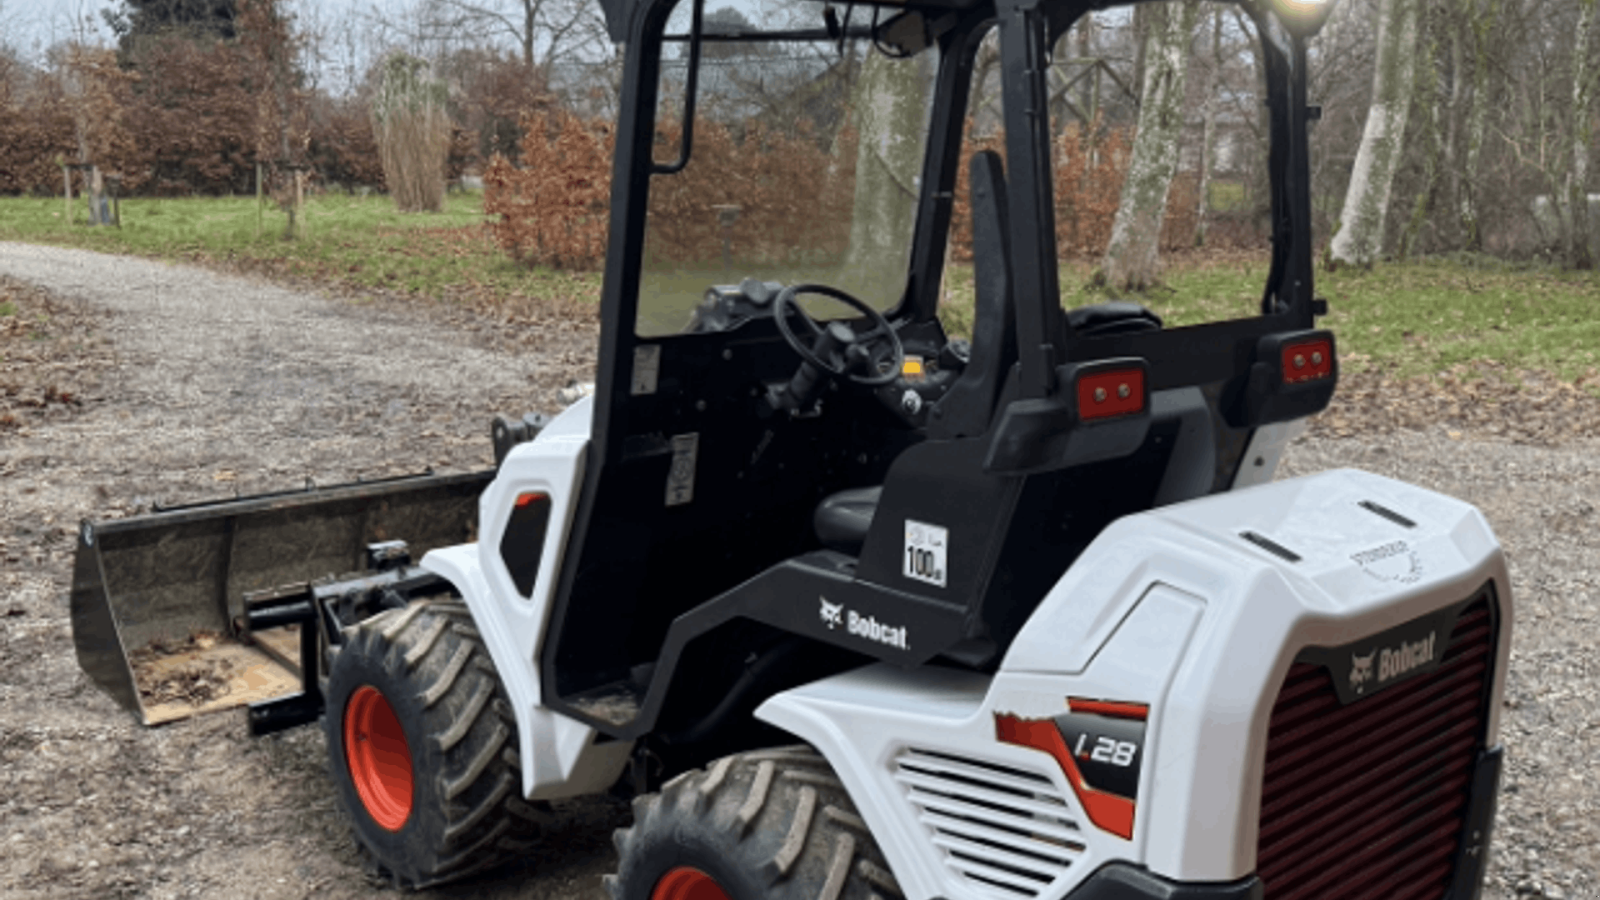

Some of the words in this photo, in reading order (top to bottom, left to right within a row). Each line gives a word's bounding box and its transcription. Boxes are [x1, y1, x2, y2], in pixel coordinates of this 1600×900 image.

[907, 545, 935, 578] 100
[847, 609, 907, 650] Bobcat
[1379, 630, 1436, 682] Bobcat
